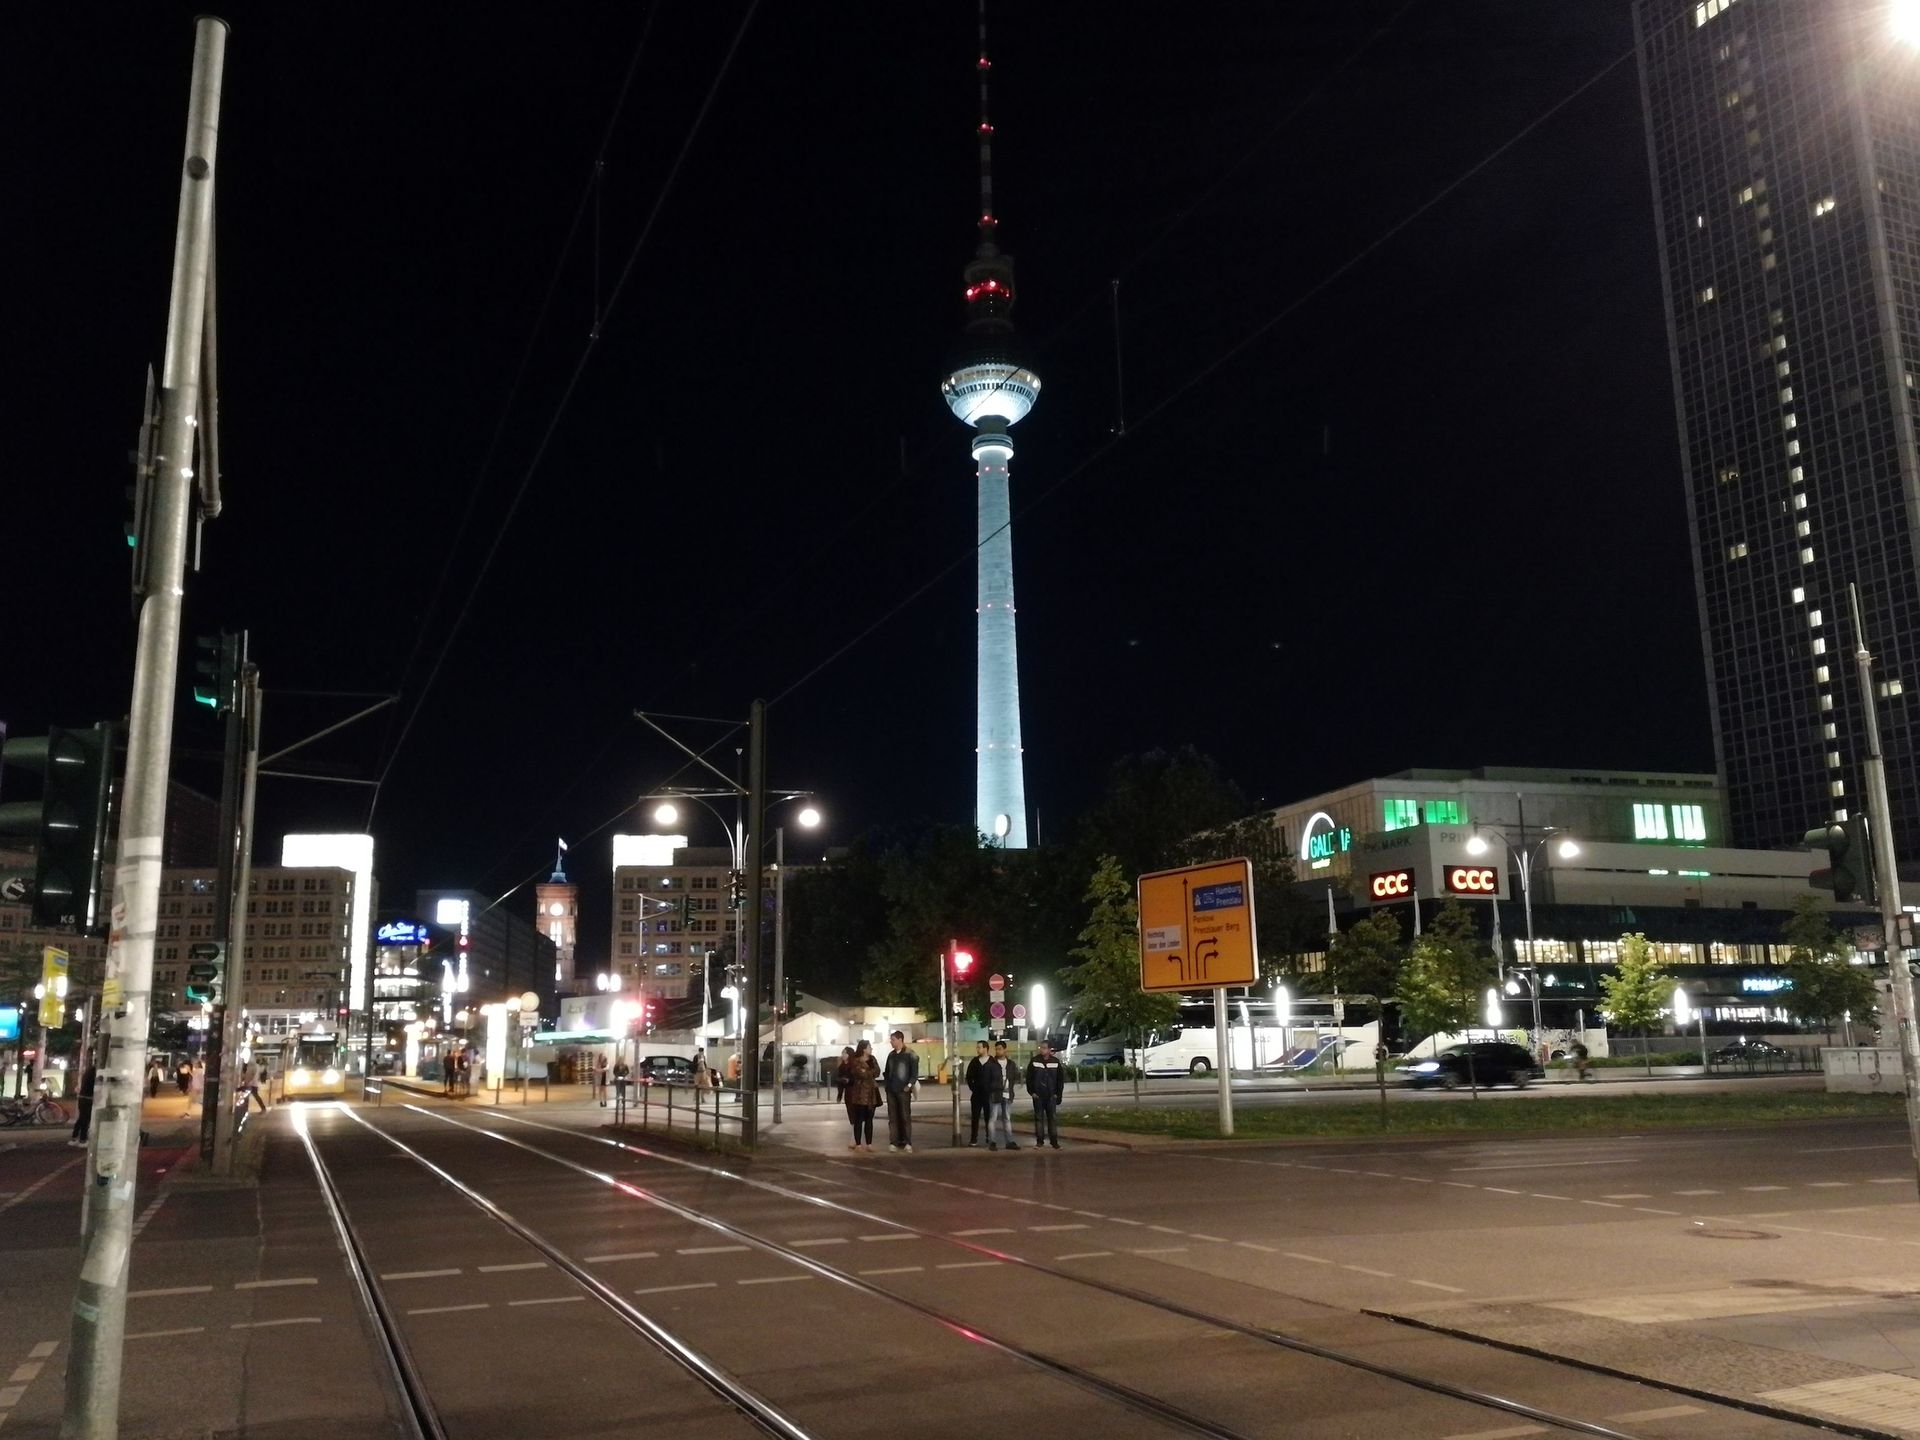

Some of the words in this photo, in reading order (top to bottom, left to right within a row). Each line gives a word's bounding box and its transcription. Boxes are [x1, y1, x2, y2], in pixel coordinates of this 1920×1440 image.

[1373, 873, 1409, 896] CCC
[1452, 869, 1494, 891] CCC
[60, 914, 76, 924] K5
